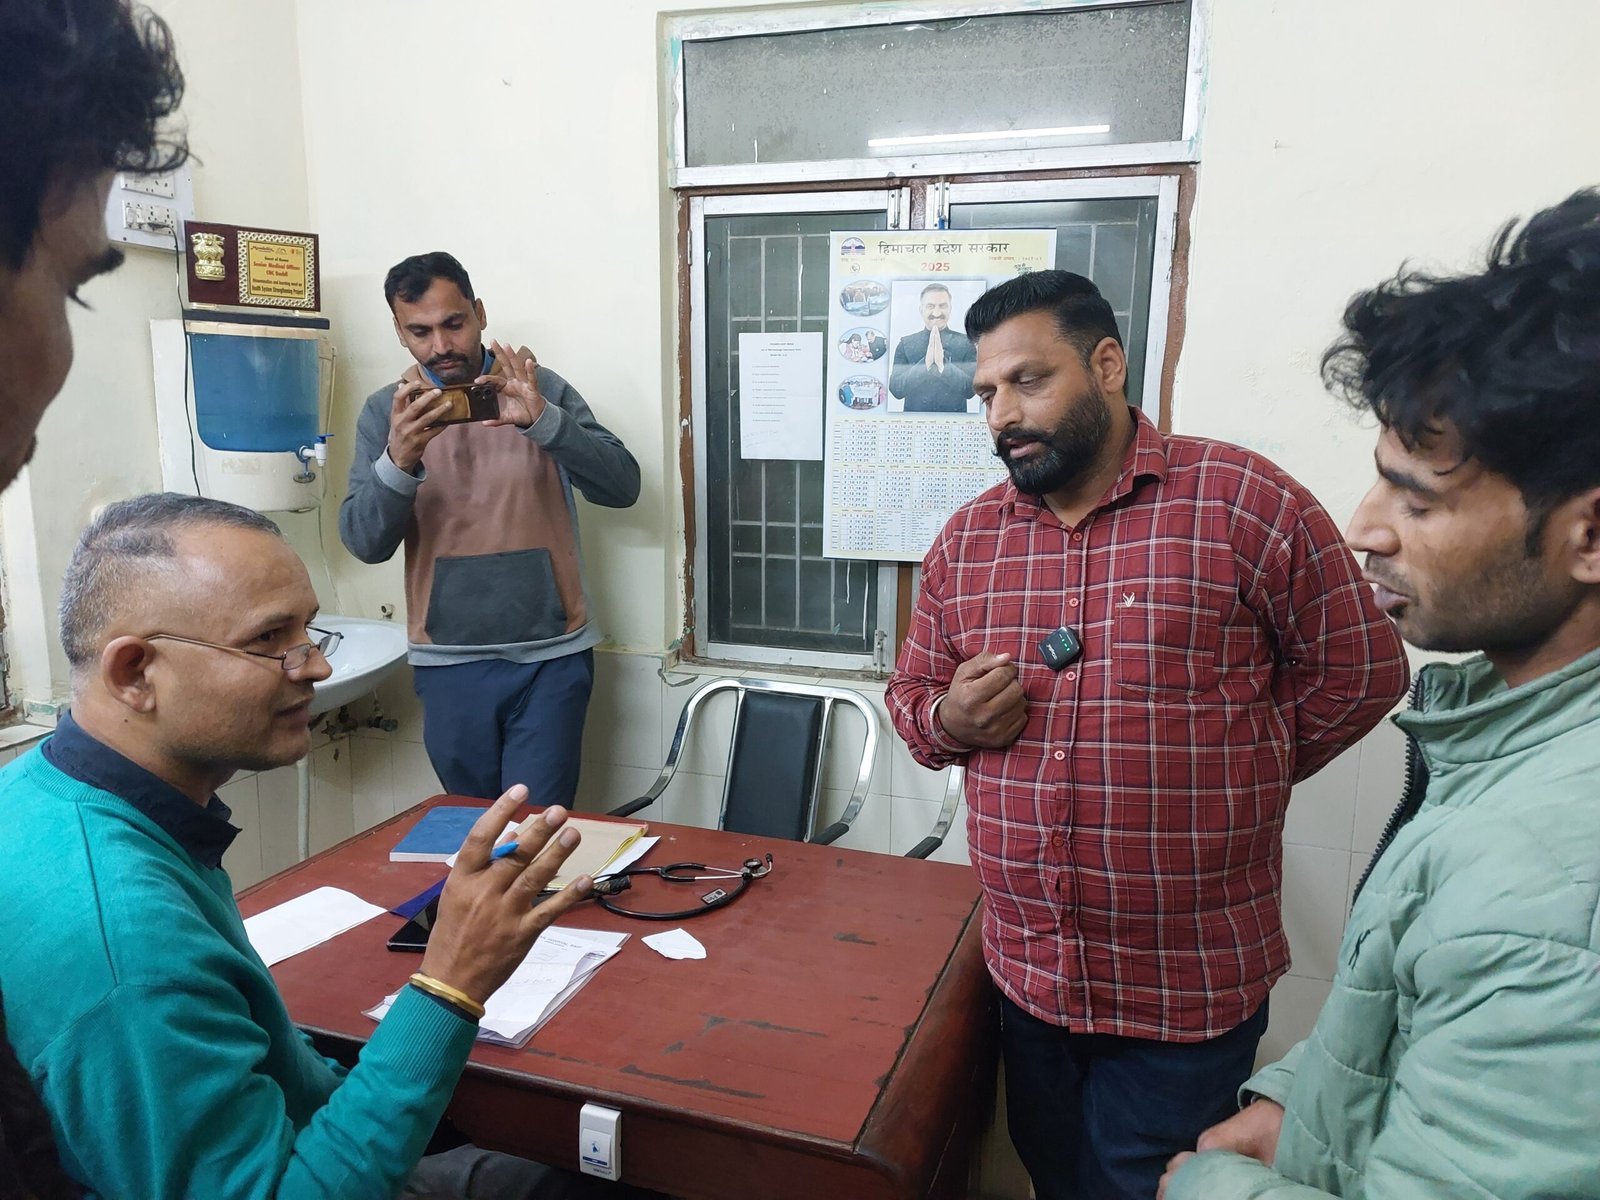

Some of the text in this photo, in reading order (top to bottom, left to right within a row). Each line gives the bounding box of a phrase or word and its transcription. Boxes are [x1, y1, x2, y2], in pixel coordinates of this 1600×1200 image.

[878, 240, 1010, 255] हिमाचल प्रदेश सरकार
[920, 262, 950, 272] 2025
